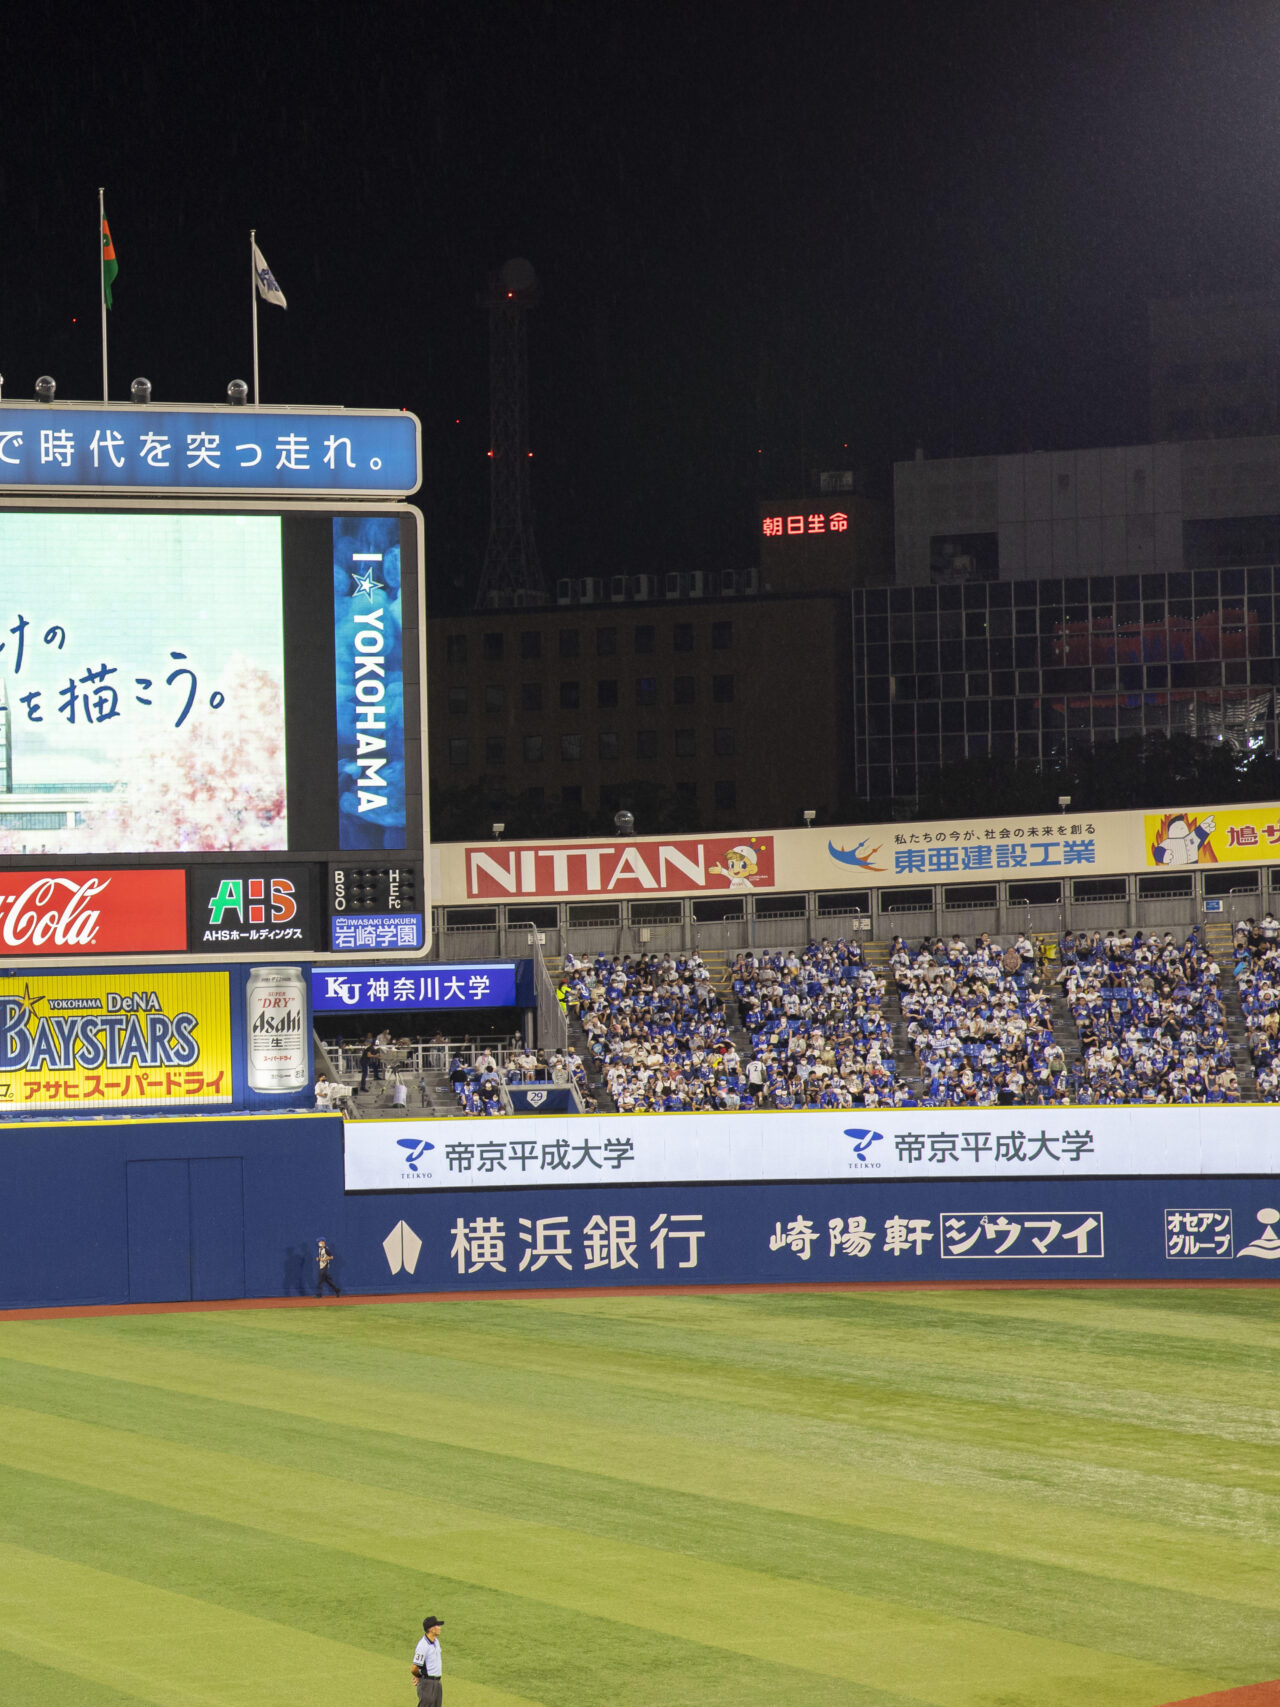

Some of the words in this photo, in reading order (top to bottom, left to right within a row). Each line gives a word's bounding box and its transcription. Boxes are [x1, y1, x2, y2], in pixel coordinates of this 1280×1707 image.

[762, 512, 848, 537] 朝日生命
[352, 553, 383, 561] I
[353, 607, 388, 813] YOKOHAMA
[894, 823, 1097, 845] 私たちの今が、社会の未来を創る
[894, 838, 1096, 875] 東亜建設工業
[334, 870, 345, 884] B
[388, 869, 400, 882] H
[470, 843, 705, 894] NITTAN
[335, 884, 346, 897] S
[389, 883, 400, 896] E
[208, 878, 297, 924] AHS
[334, 897, 346, 910] O
[348, 918, 382, 926] IWASAKI
[383, 917, 417, 925] GAKUEN
[202, 928, 303, 941] AHSホールディングス
[335, 925, 417, 947] 岩崎学園
[325, 976, 362, 1005] KU
[367, 975, 490, 1002] 神奈川大学
[48, 998, 103, 1010] YOKOHAMA
[106, 991, 162, 1013] DeNA
[252, 1009, 301, 1034] Asahi
[270, 1037, 284, 1048] 生
[23, 1070, 224, 1101] アサヒスーパードライ
[530, 1091, 544, 1101] 29
[445, 1137, 635, 1174] 帝京平成大学
[893, 1129, 1095, 1164] 帝京平成大学
[1167, 1212, 1230, 1233] オセアン
[450, 1213, 705, 1275] 横浜銀行
[769, 1214, 934, 1261] 崎陽軒
[944, 1214, 1098, 1255] シウマイ
[1168, 1234, 1231, 1255] グループ
[415, 1653, 424, 1662] 31
